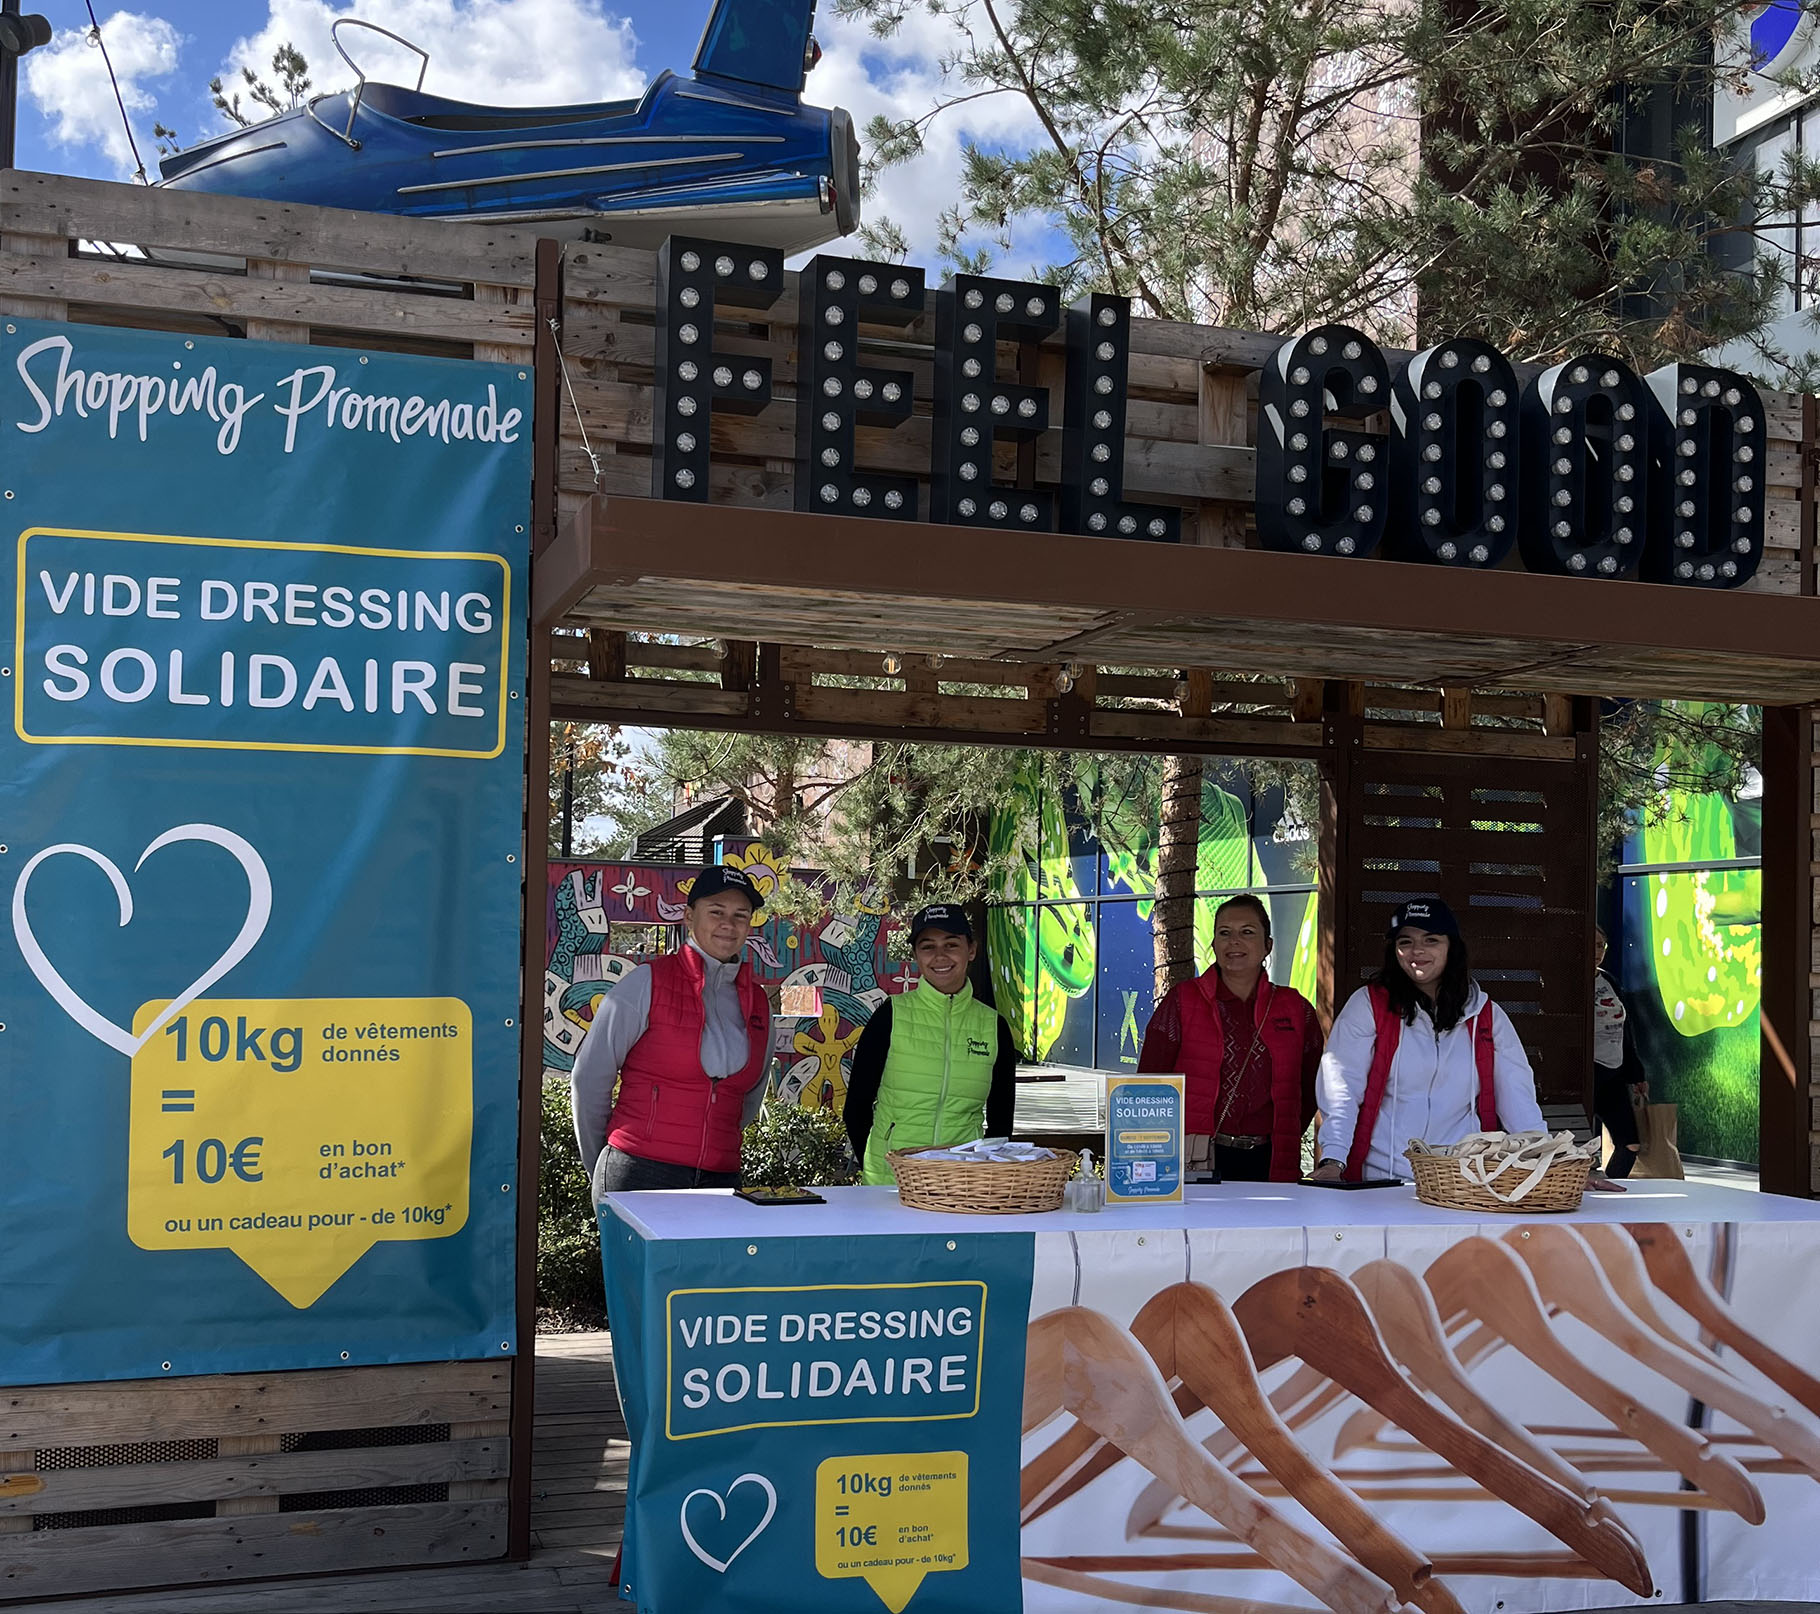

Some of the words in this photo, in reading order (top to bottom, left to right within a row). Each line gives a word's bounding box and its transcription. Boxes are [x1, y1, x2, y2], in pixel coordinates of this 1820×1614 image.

[16, 335, 265, 455] Shopping
[273, 365, 523, 453] Promenade
[656, 234, 1181, 543] FEEL
[1256, 325, 1766, 588] GOOD
[40, 570, 181, 618] VIDE
[200, 580, 493, 634] DRESSING
[43, 644, 486, 717] SOLIDAIRE
[322, 1023, 348, 1040] de
[354, 1021, 459, 1040] vêtements
[165, 1016, 303, 1073] 10kg
[321, 1045, 400, 1063] donnés
[162, 1090, 195, 1112] =
[1115, 1096, 1134, 1104] VIDE
[1116, 1107, 1174, 1118] SOLIDAIRE
[319, 1144, 345, 1157] en
[352, 1139, 392, 1156] bon
[162, 1137, 264, 1184] 10€
[165, 1219, 191, 1232] ou
[198, 1218, 223, 1231] un
[230, 1213, 302, 1230] cadeau
[308, 1213, 355, 1230] pour
[371, 1206, 396, 1225] de
[679, 1314, 768, 1348] VIDE
[779, 1307, 973, 1342] DRESSING
[683, 1355, 968, 1409] SOLIDAIRE
[836, 1473, 892, 1497] 10kg
[898, 1474, 910, 1482] de
[912, 1472, 957, 1481] vêtements
[835, 1505, 849, 1516] =
[836, 1525, 877, 1547] 10€
[912, 1525, 929, 1533] bon
[838, 1561, 848, 1569] ou
[863, 1558, 893, 1567] cadeau
[895, 1557, 914, 1567] pour
[921, 1555, 931, 1564] de
